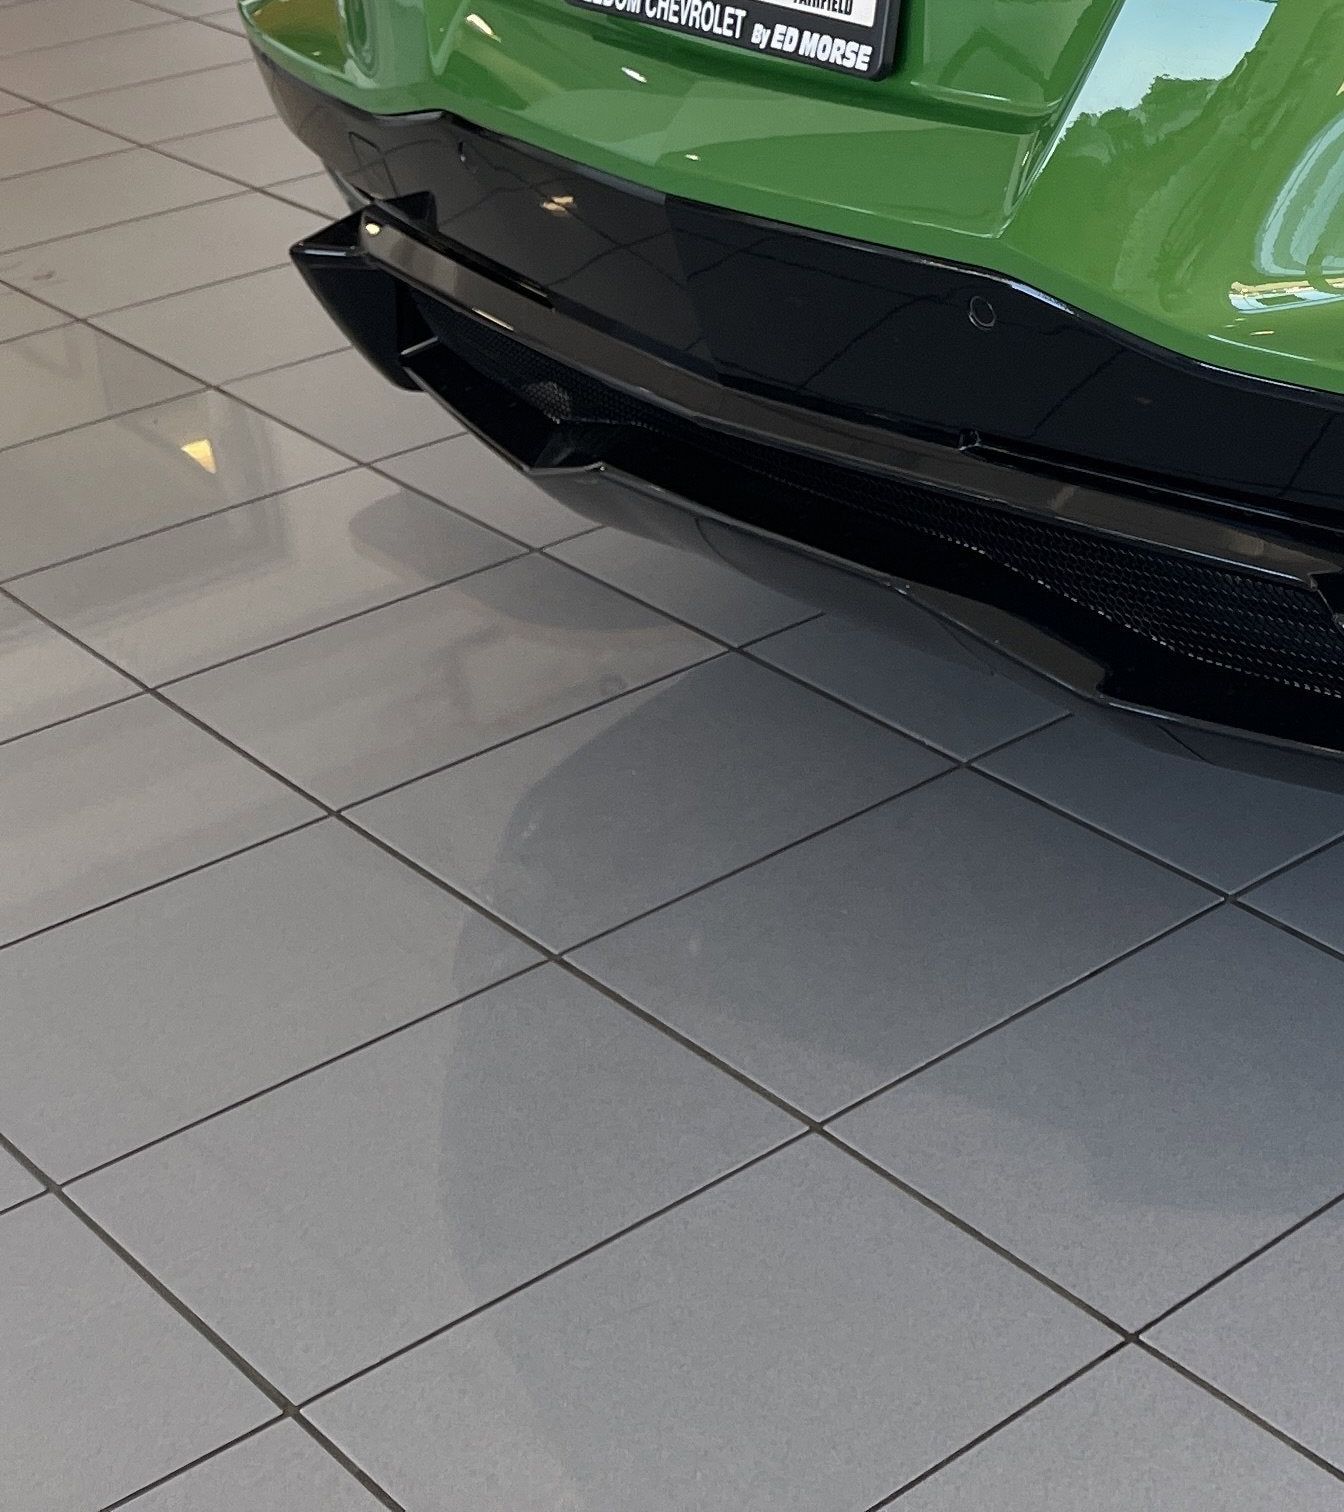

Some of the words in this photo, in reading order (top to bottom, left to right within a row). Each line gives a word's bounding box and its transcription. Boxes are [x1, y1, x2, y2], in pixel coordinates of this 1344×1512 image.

[751, 22, 772, 49] By
[771, 24, 799, 53] ED
[799, 32, 873, 72] MORSE
